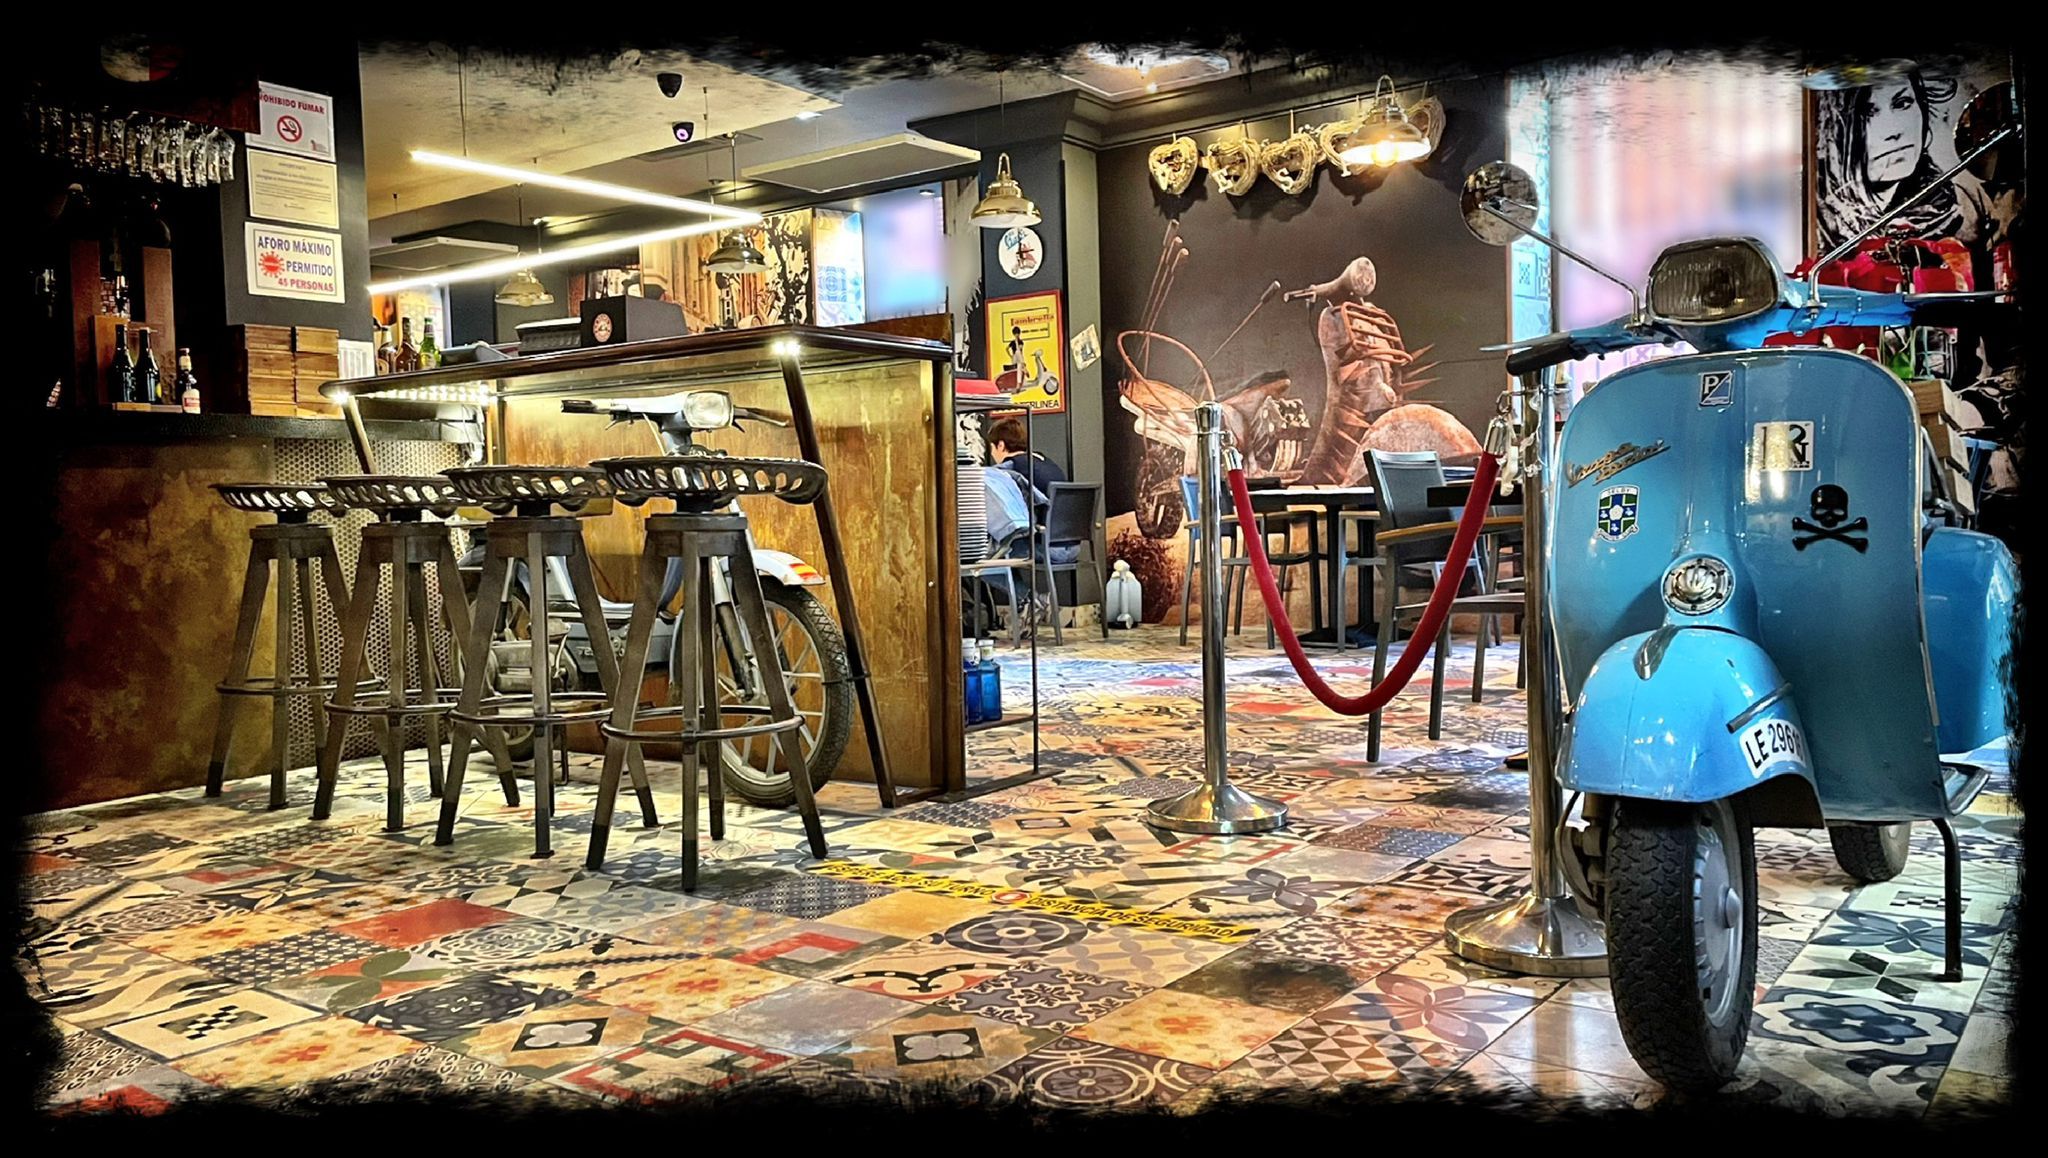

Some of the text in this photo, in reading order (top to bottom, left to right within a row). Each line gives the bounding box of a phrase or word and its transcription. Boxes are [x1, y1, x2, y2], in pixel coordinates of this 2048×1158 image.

[259, 93, 325, 114] OHIBIDO FUMAR
[1276, 168, 1293, 192] S
[258, 236, 331, 256] AFORO MÁXIMO
[286, 261, 333, 276] PERMITIDO
[278, 278, 334, 292] 45 PERSONAS
[1704, 375, 1720, 394] P
[1745, 729, 1770, 769] LE
[943, 882, 997, 896] TURNO
[1026, 897, 1109, 917] DISTANCIA
[1108, 911, 1134, 921] DE
[1135, 913, 1234, 938] SEGURIDAD
